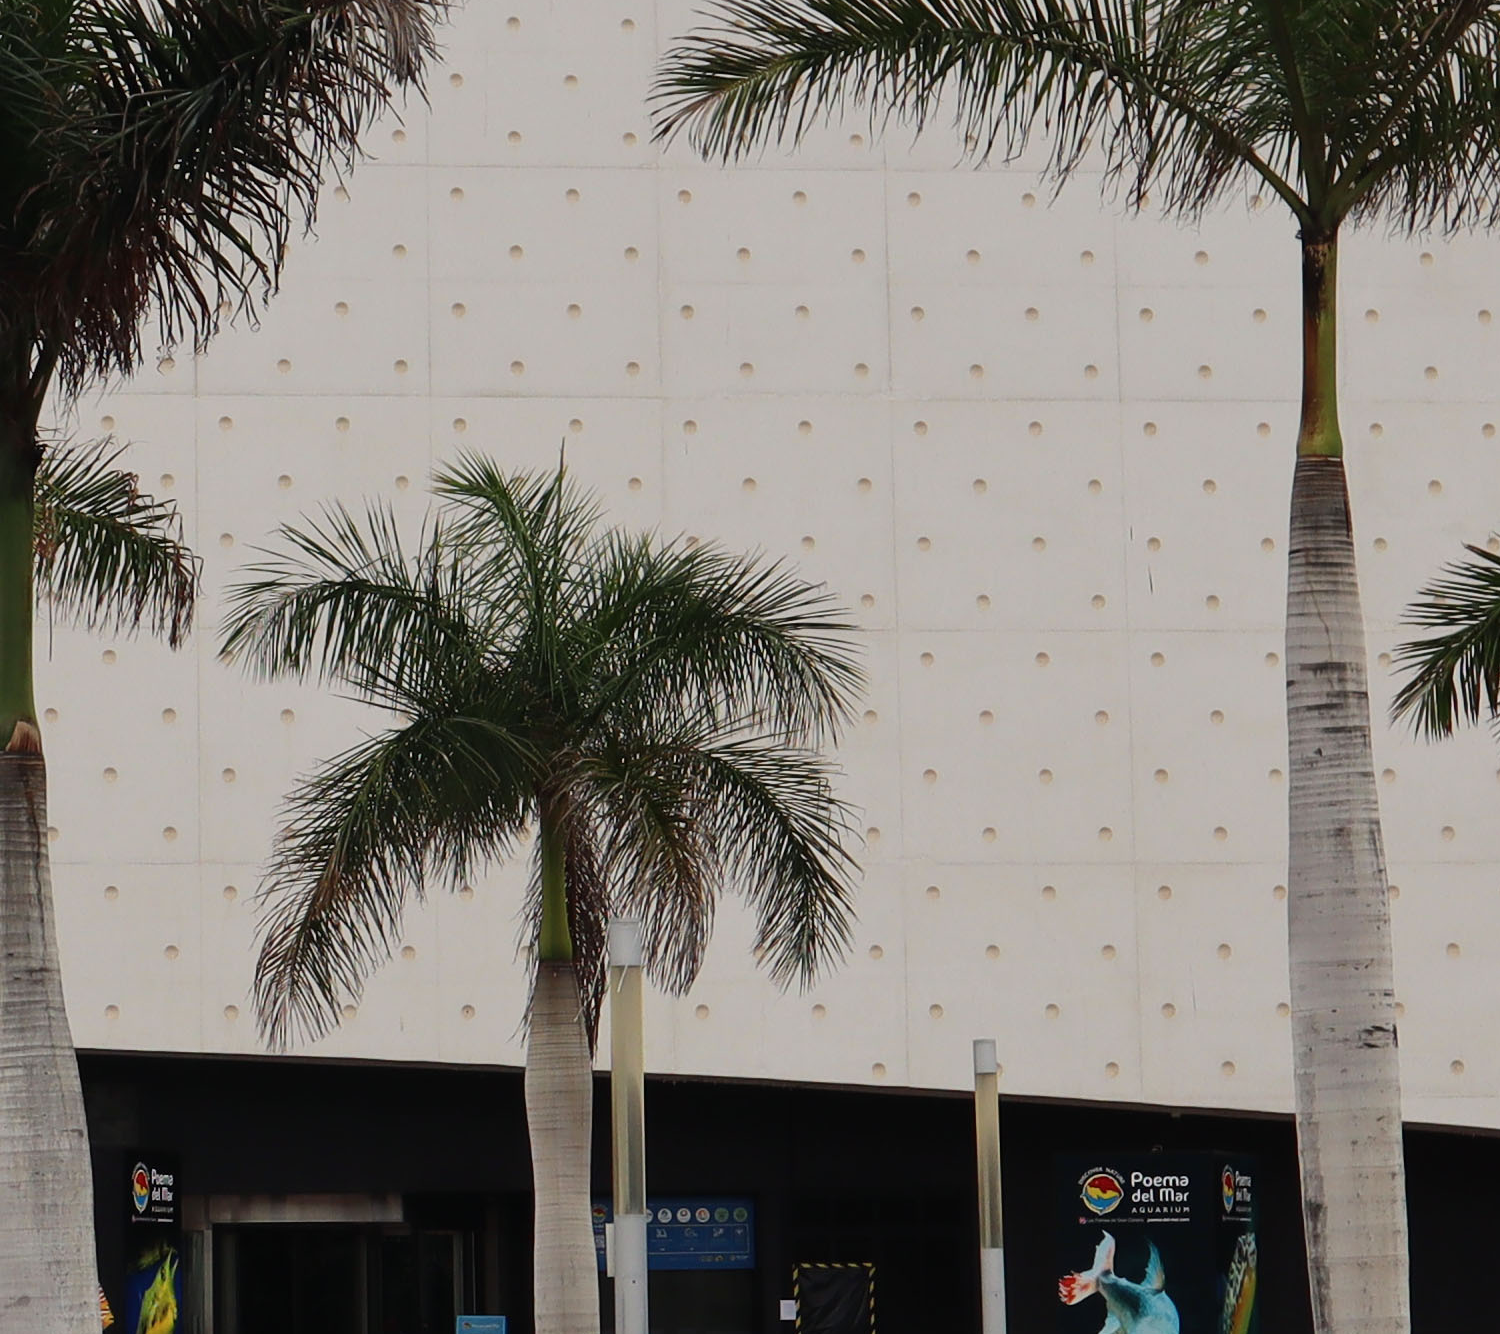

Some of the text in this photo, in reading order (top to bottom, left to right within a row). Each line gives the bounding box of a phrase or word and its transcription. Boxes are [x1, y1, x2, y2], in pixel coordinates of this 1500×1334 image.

[1131, 1171, 1190, 1187] Poema
[1131, 1187, 1190, 1203] del Mar
[1131, 1206, 1190, 1214] AQUARIUM
